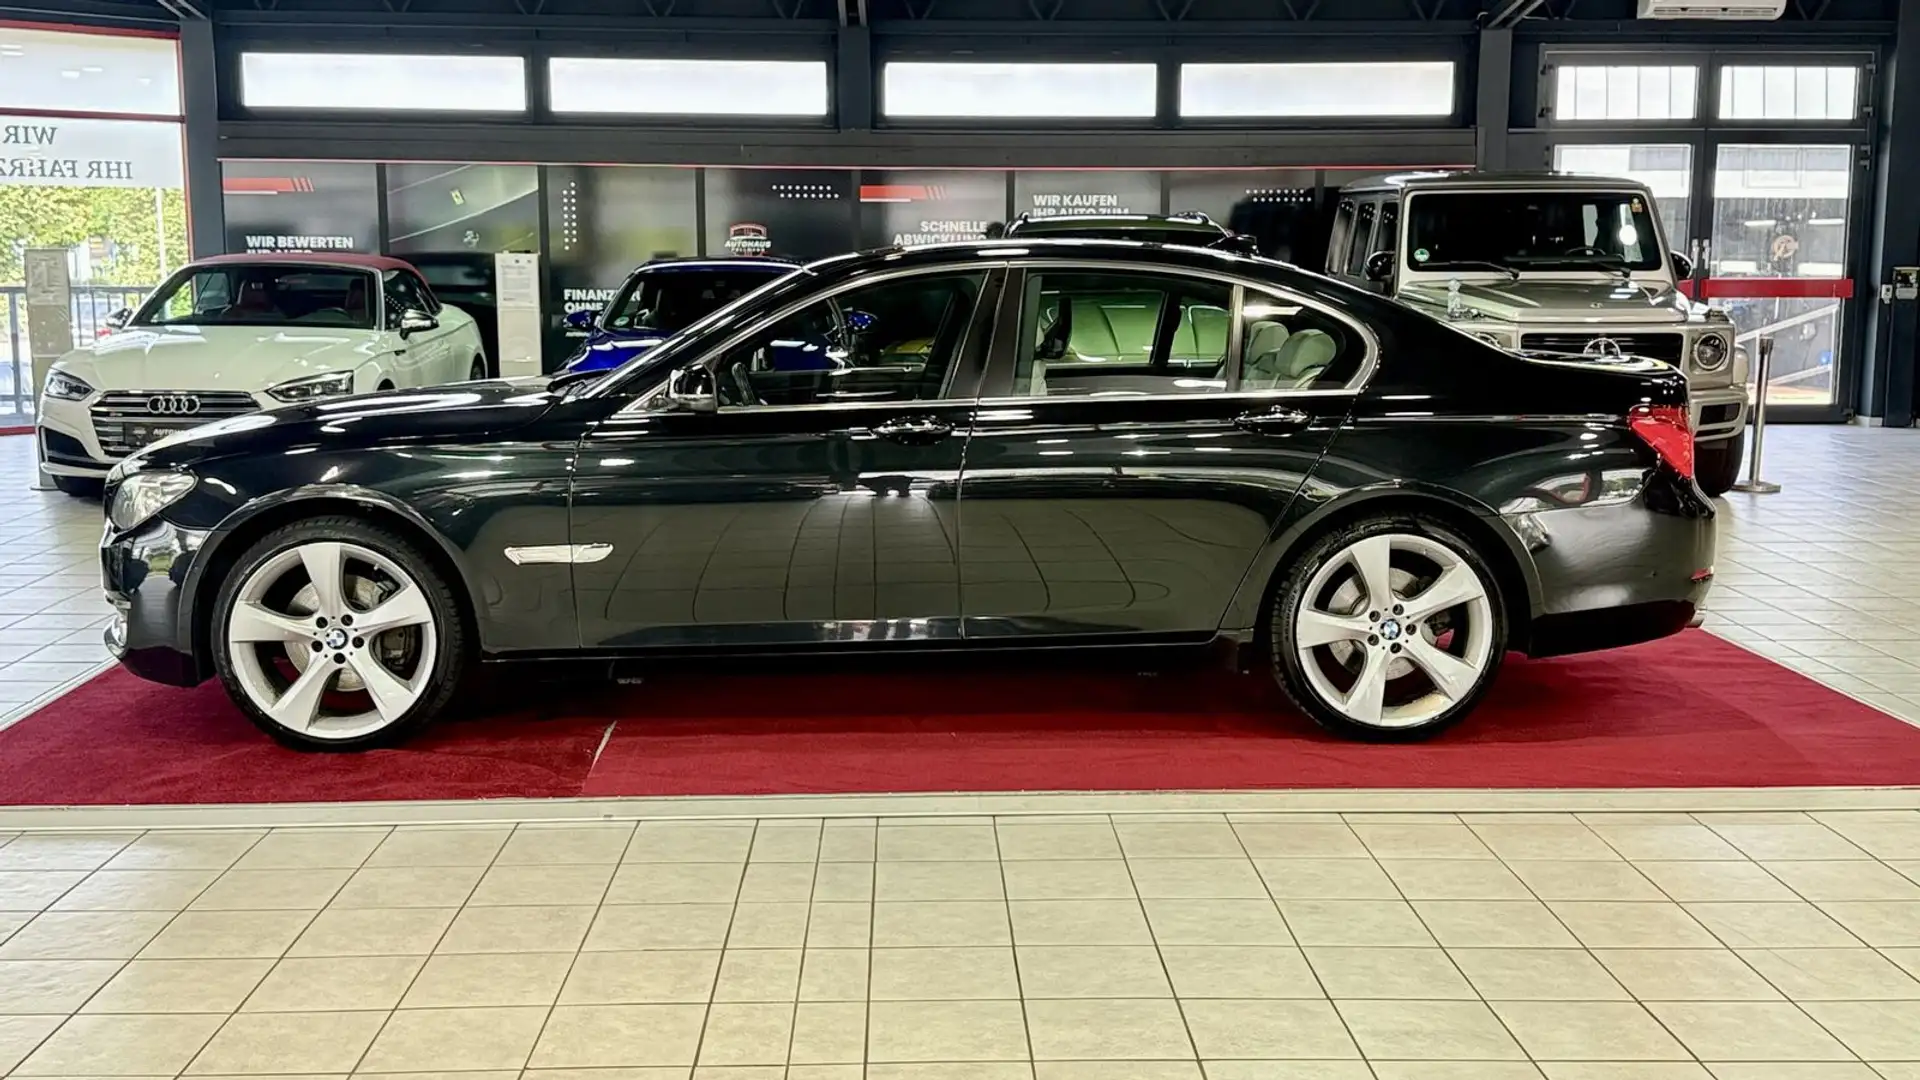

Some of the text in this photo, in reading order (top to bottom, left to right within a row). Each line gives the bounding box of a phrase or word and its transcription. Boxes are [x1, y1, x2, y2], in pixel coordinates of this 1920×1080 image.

[1033, 194, 1117, 206] WIR KAUFEN
[920, 220, 988, 233] SCHNELLE
[246, 235, 353, 249] WIR BEWERTEN
[724, 240, 772, 249] AUTOHAUS
